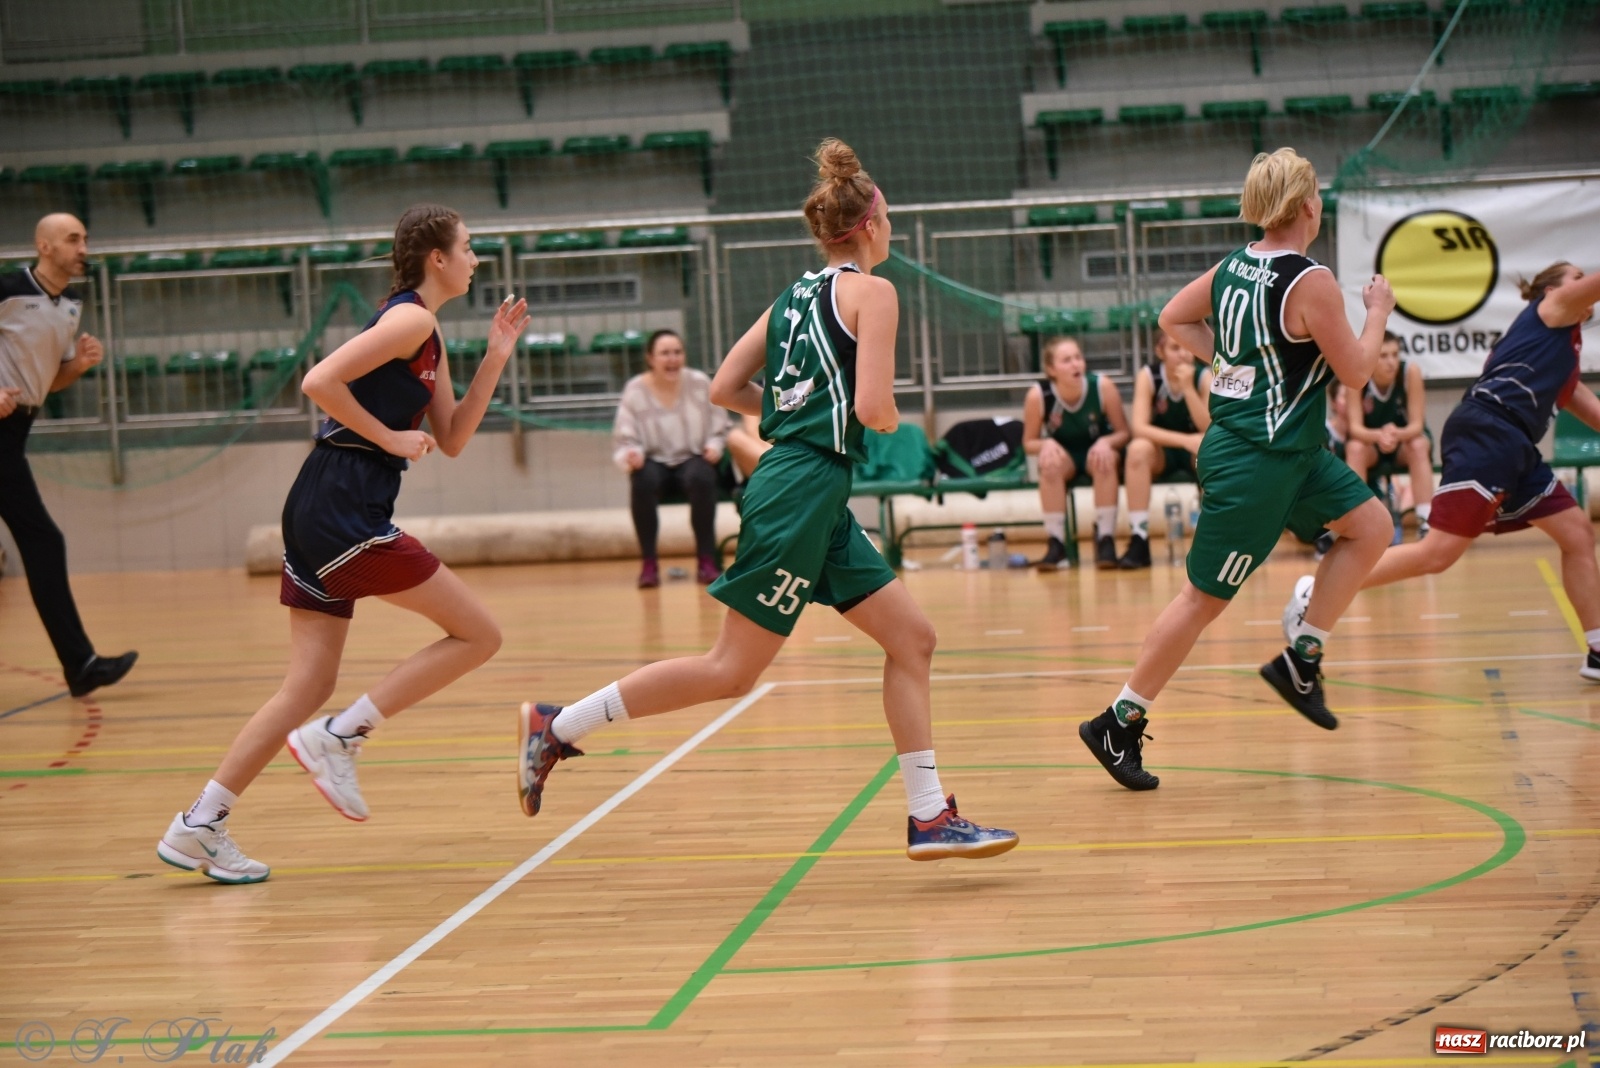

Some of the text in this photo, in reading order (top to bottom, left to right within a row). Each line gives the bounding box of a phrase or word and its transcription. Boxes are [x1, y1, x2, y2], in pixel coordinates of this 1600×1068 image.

[1218, 284, 1250, 359] 10
[1398, 326, 1502, 355] ACIBÓRZ
[1216, 550, 1253, 587] 10
[756, 567, 811, 615] 35
